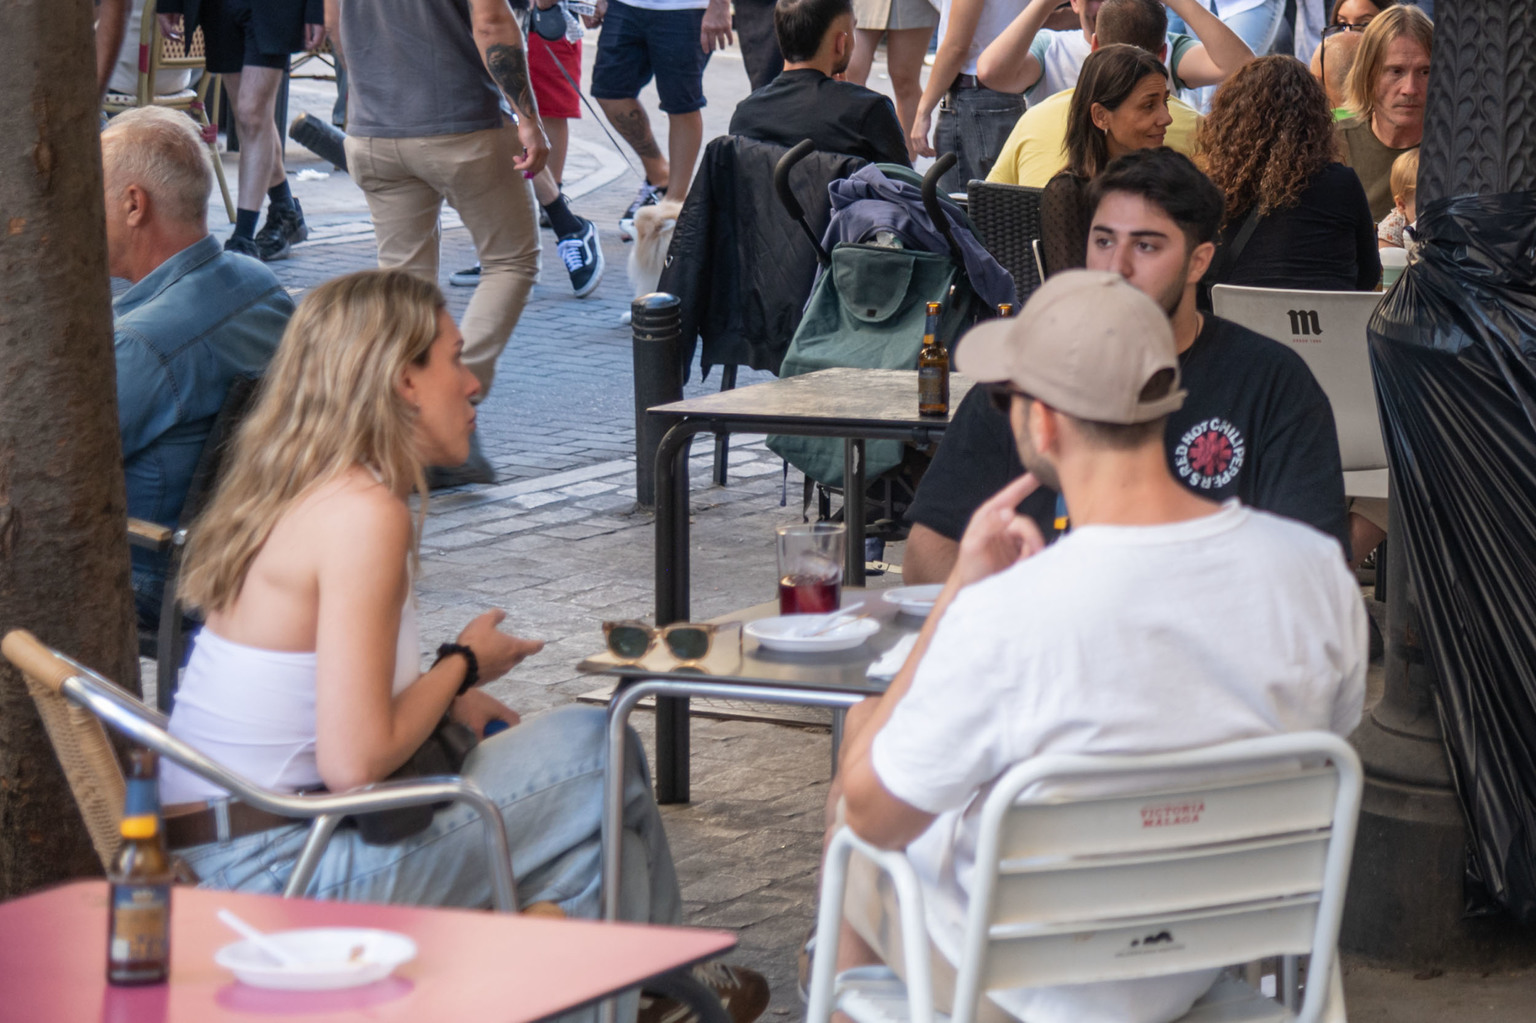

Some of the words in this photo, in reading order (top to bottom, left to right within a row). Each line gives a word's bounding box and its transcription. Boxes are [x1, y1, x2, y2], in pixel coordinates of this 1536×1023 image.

[1181, 420, 1209, 445] HOT
[1210, 417, 1244, 448] CHILI
[1175, 445, 1193, 477] RED
[1188, 446, 1245, 489] PEPPERS
[1141, 802, 1205, 818] VICTORIA
